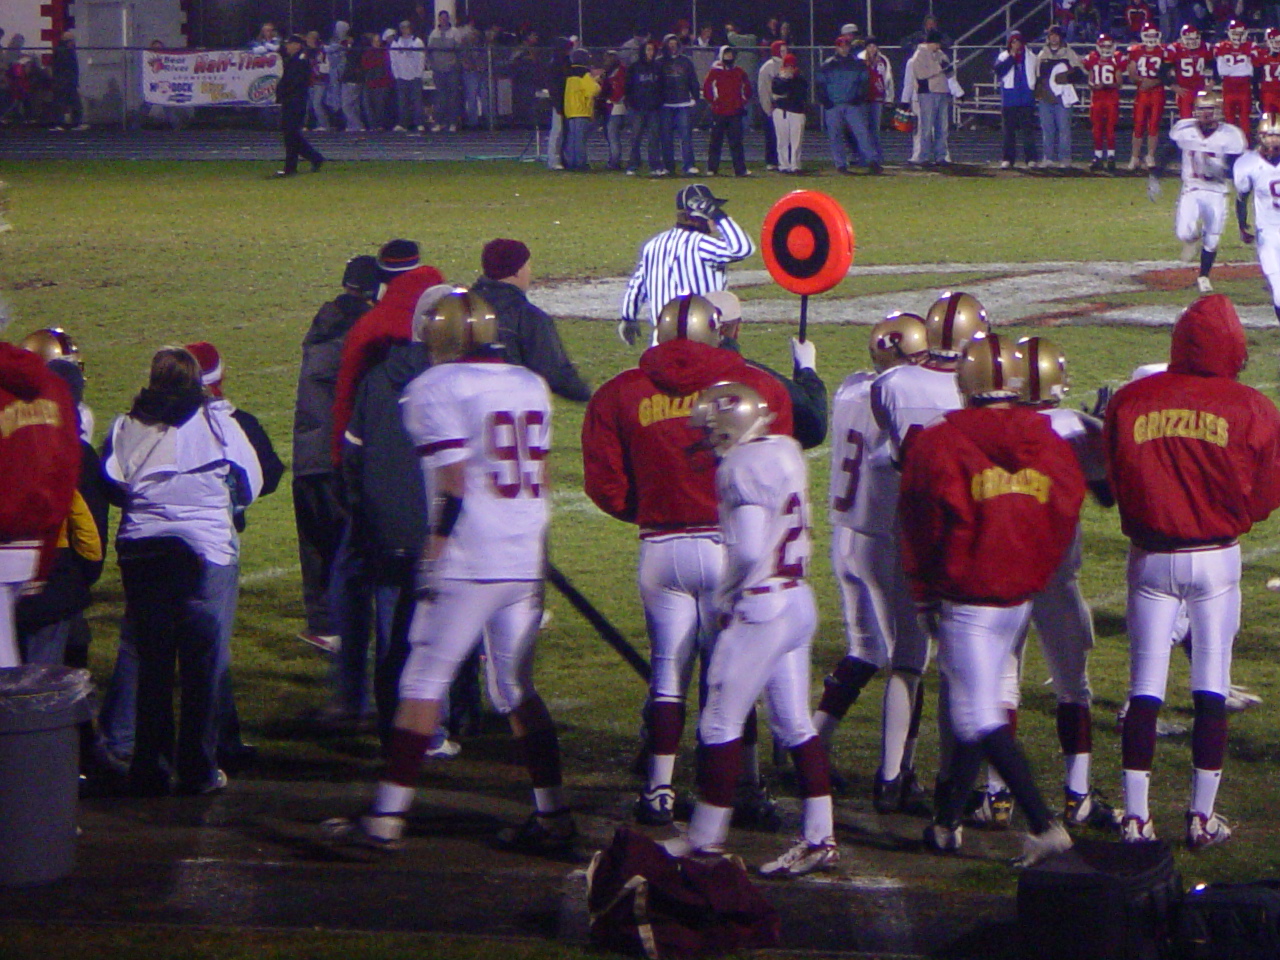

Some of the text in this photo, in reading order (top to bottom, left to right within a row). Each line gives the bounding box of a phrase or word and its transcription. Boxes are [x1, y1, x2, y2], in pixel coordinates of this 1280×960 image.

[1093, 64, 1115, 85] 16
[1137, 56, 1162, 77] 43
[1180, 57, 1206, 77] 54
[1133, 409, 1230, 449] GRIZZLIES
